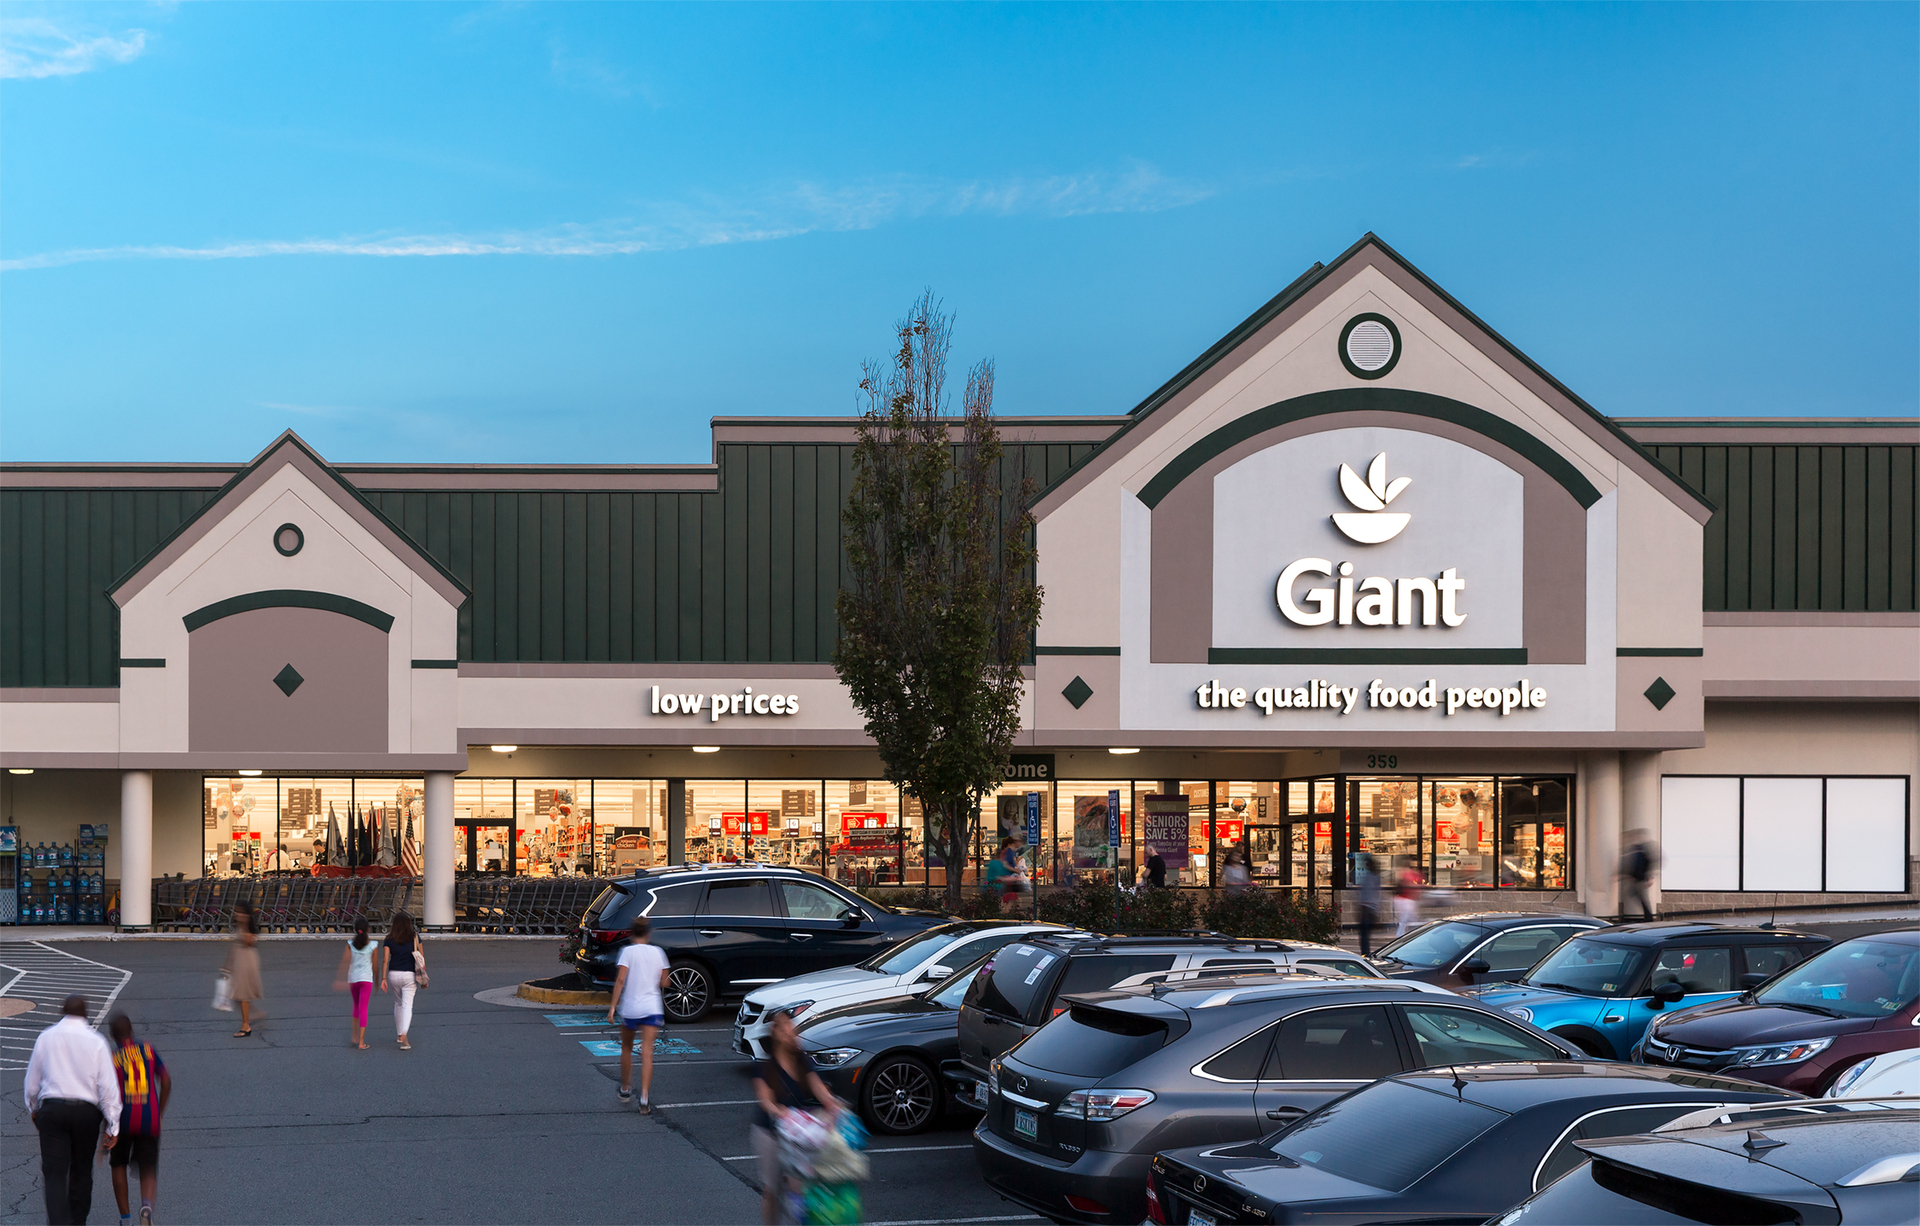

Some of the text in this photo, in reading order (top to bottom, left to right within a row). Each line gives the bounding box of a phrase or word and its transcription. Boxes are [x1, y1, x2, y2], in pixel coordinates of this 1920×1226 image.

[1276, 557, 1468, 628] Giant
[651, 685, 800, 722] low prices
[1197, 679, 1548, 716] the quality food people
[1367, 754, 1398, 769] 359
[1156, 802, 1177, 811] Vienna
[1146, 815, 1188, 828] SENIORS
[1146, 828, 1188, 840] SAVE 5%
[616, 841, 635, 849] chicken
